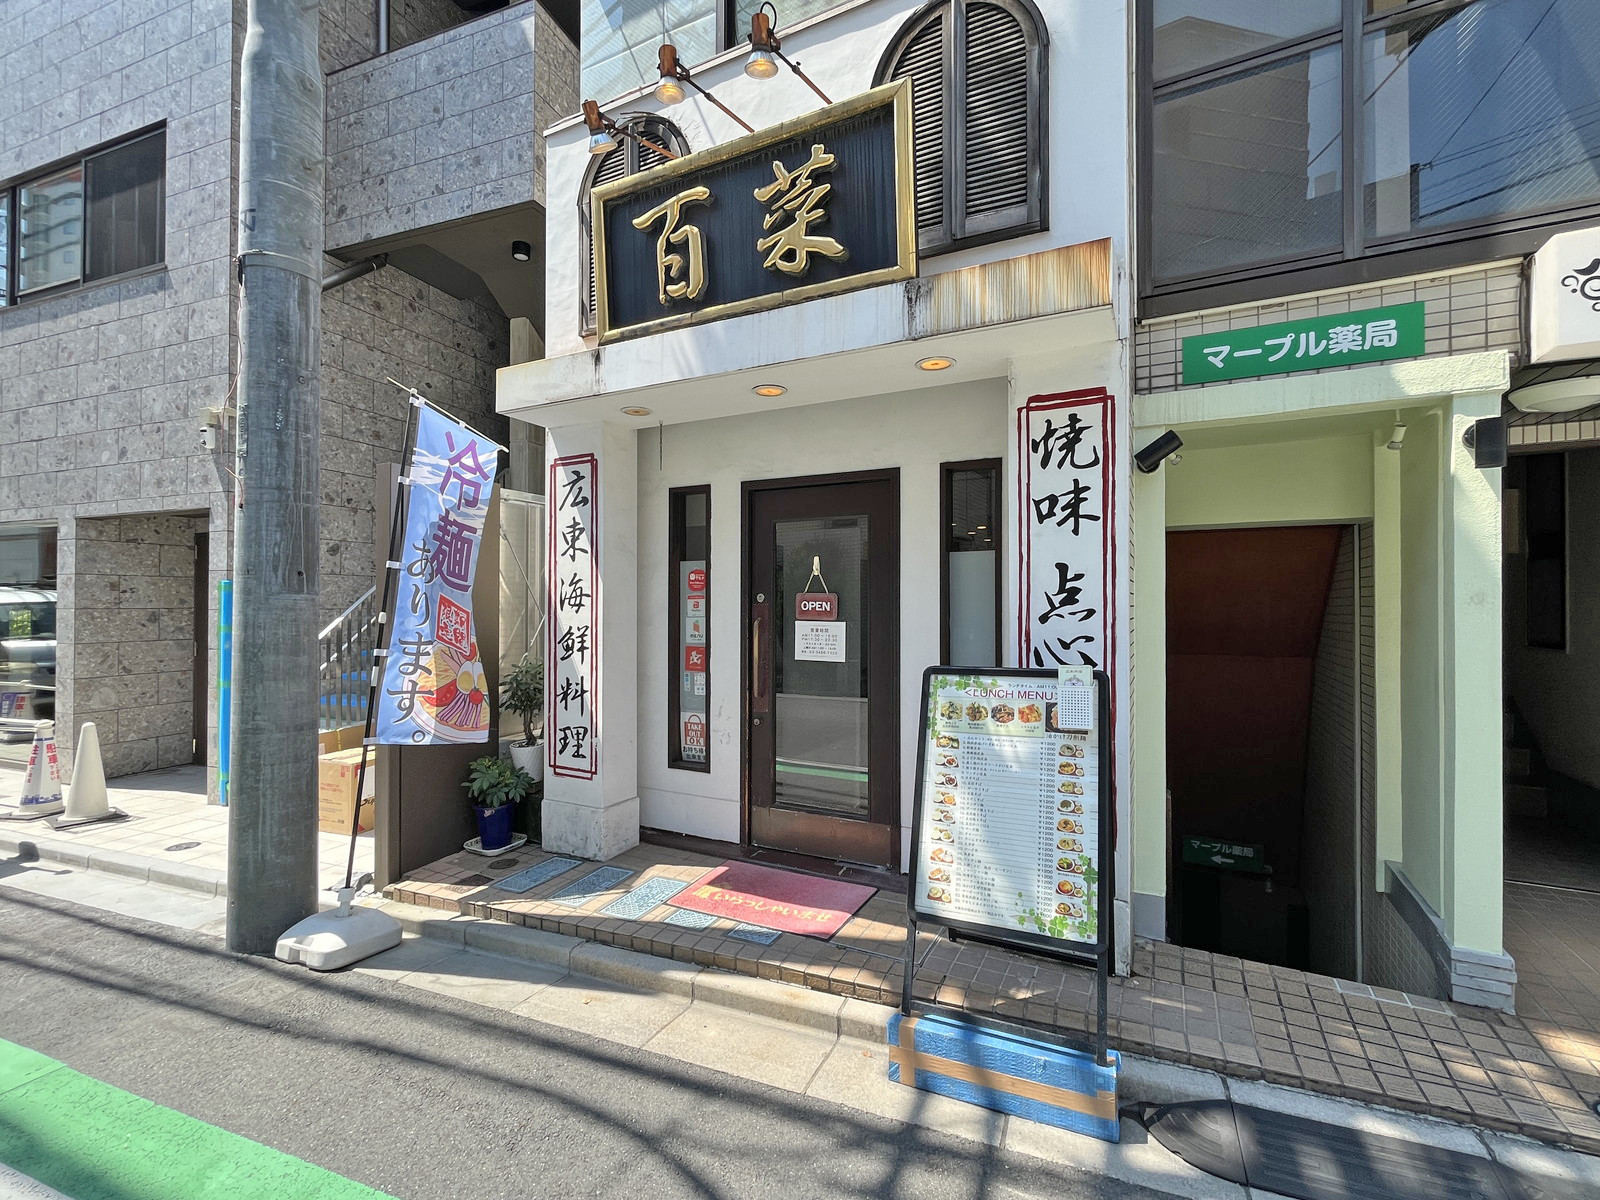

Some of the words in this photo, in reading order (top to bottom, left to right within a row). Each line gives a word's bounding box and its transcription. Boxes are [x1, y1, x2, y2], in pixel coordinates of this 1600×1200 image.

[632, 144, 846, 305] 百菜
[1203, 319, 1398, 368] マープル薬局
[432, 431, 491, 593] 冷麺
[386, 538, 436, 745] あります。
[557, 470, 591, 760] 広東海鮮料理
[801, 601, 830, 611] OPEN
[688, 737, 702, 745] OK
